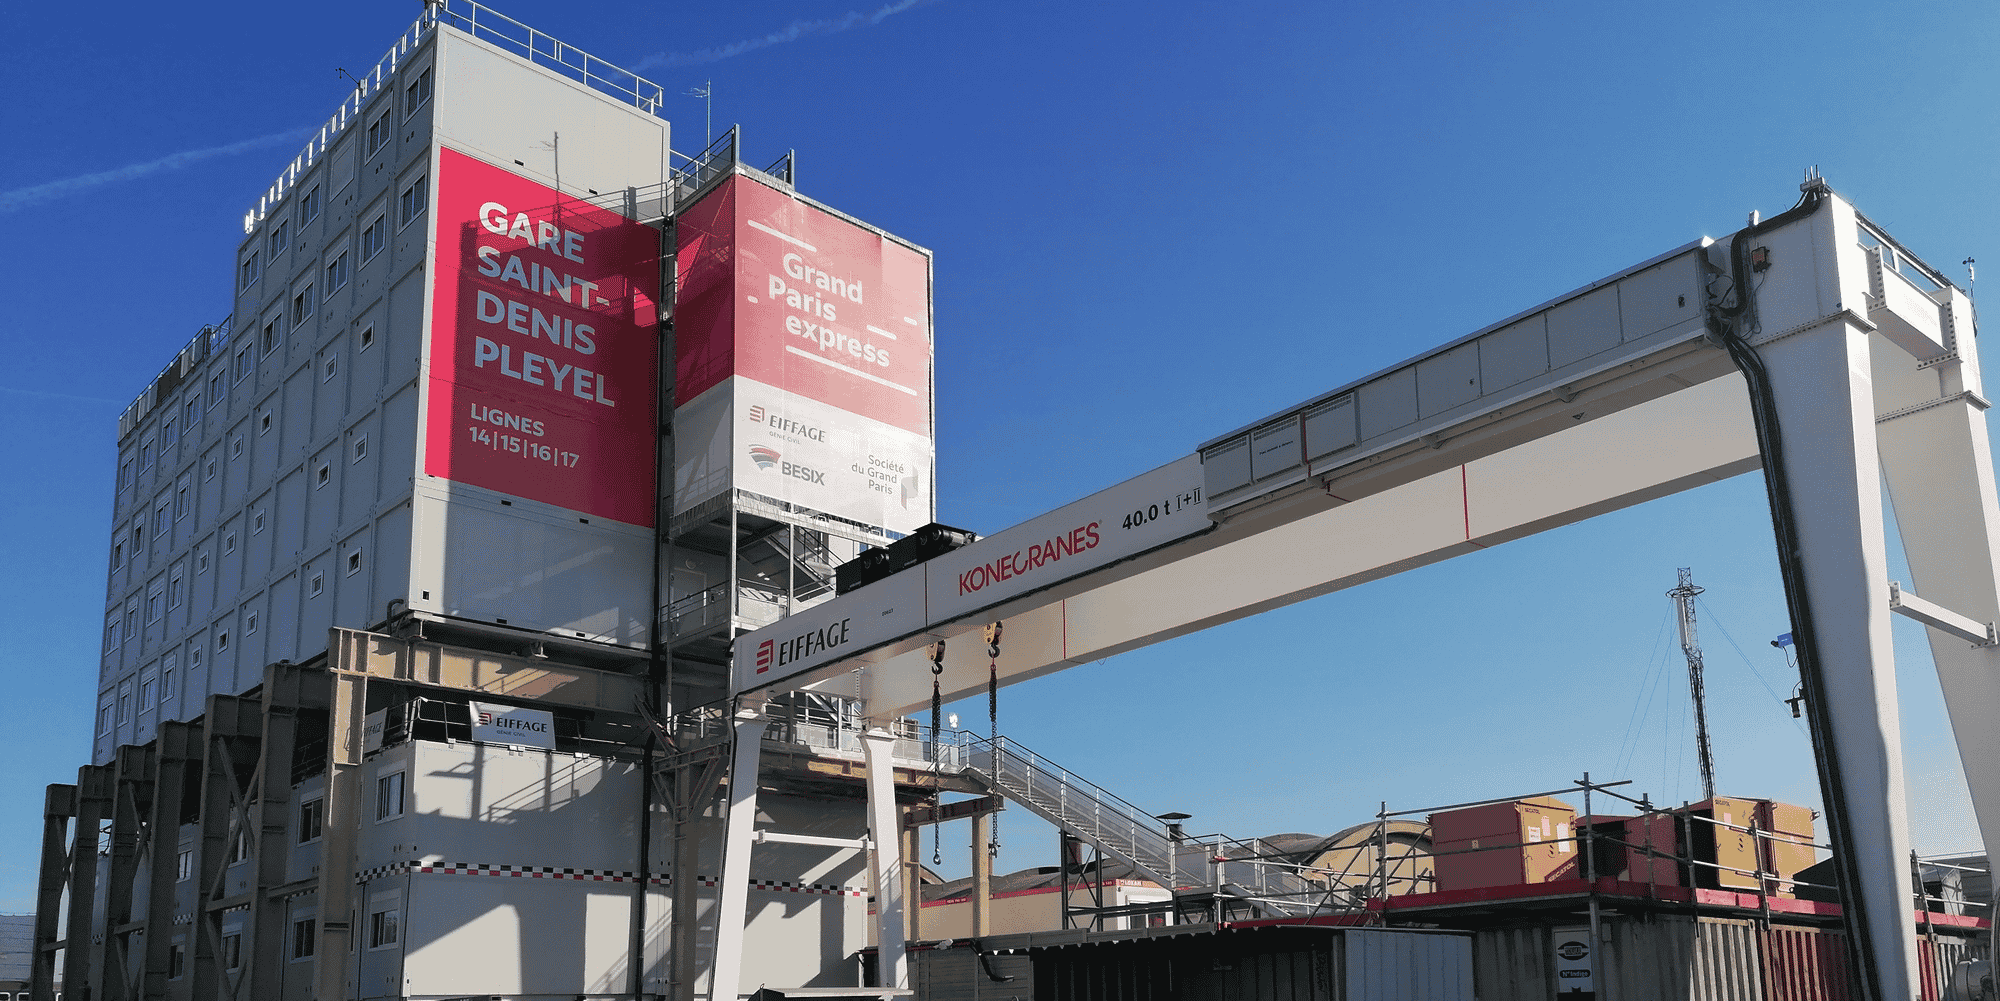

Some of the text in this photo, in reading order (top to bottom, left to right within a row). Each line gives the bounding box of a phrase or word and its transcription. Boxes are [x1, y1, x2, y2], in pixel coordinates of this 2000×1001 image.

[479, 201, 585, 264] GARE
[477, 246, 610, 309] SAINT-
[768, 273, 837, 322] Paris
[783, 252, 863, 305] Grand
[476, 289, 596, 355] DENIS
[785, 315, 890, 367] express
[474, 335, 615, 407] PLEYEL
[470, 402, 545, 437] LIGNES
[769, 414, 826, 443] EIFFAGE
[781, 460, 825, 486] BESIX
[851, 462, 898, 484] du Grand
[868, 454, 904, 474] Société
[868, 479, 893, 495] Paris
[1122, 504, 1159, 530] 40.0
[1163, 499, 1171, 516] t
[959, 521, 1100, 597] KONECRANES
[778, 617, 851, 667] EIFFAGE
[496, 717, 548, 733] EIFFAGE
